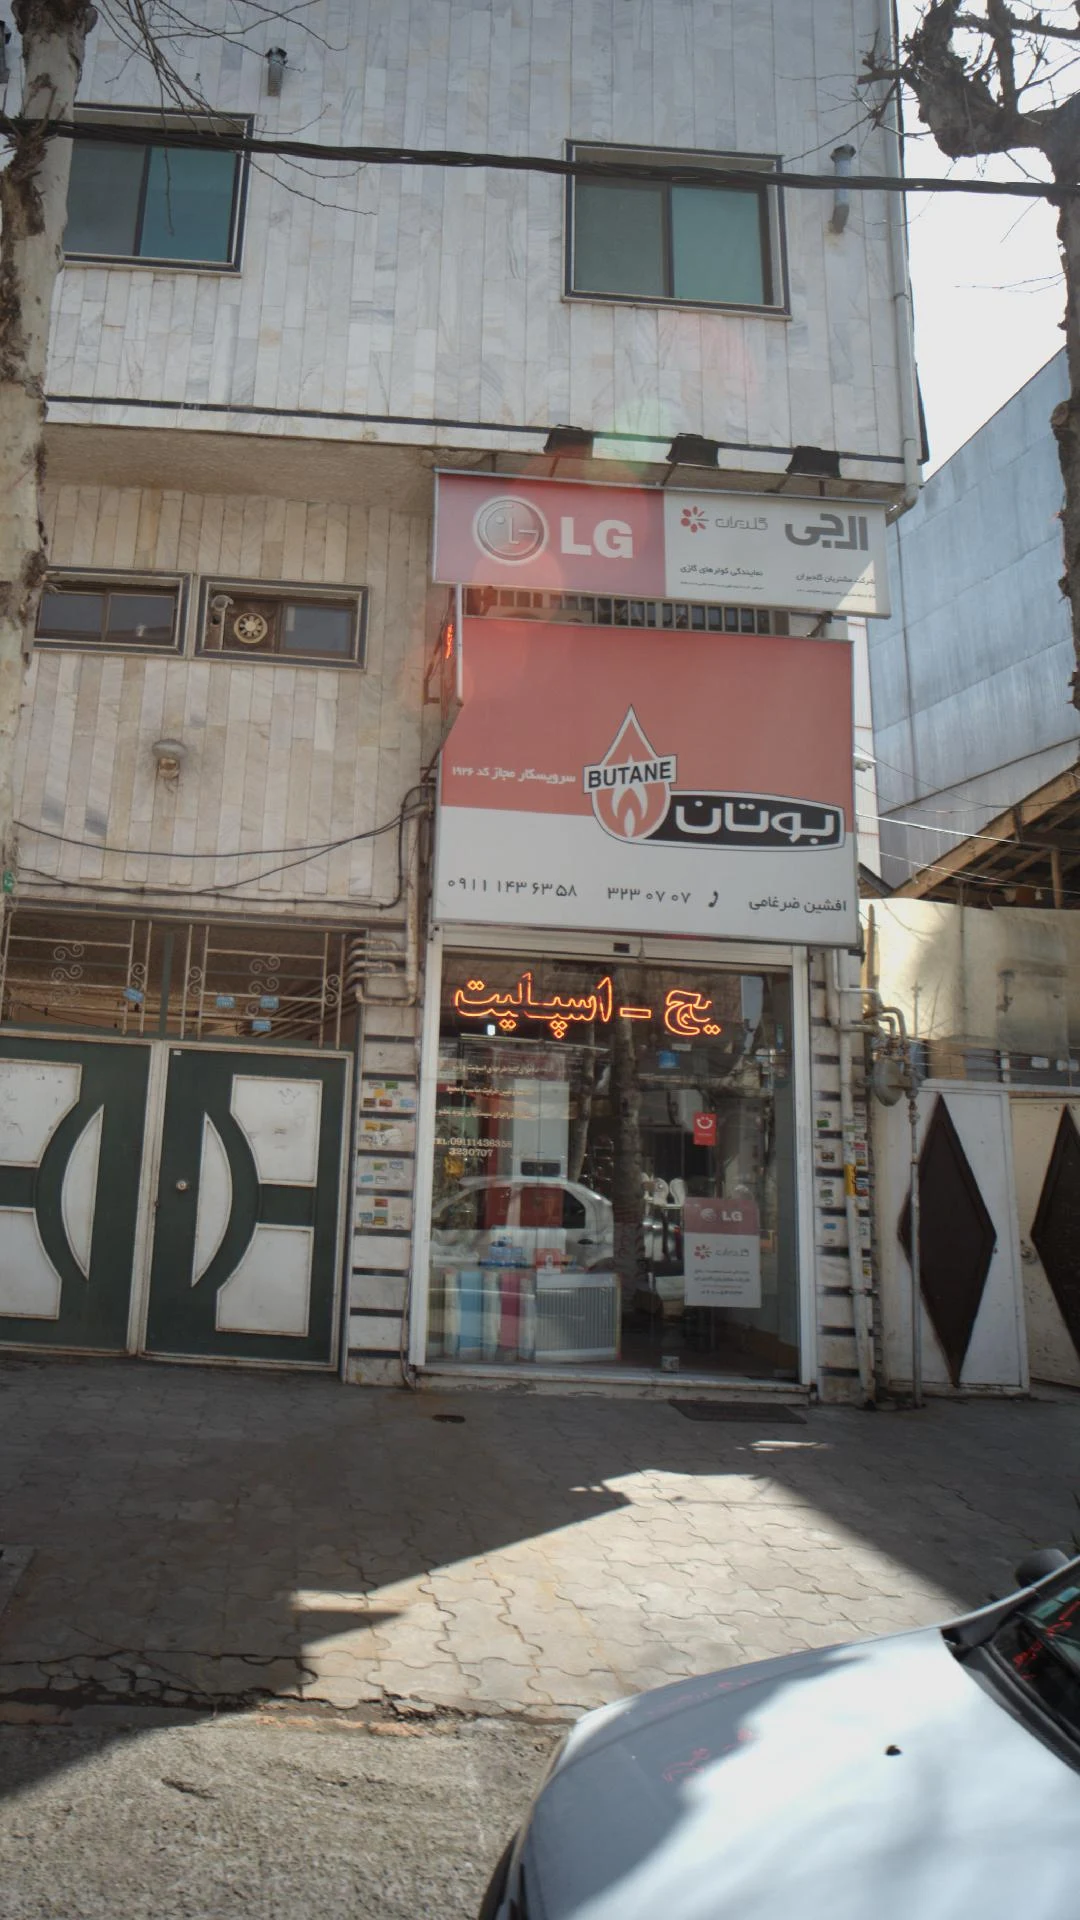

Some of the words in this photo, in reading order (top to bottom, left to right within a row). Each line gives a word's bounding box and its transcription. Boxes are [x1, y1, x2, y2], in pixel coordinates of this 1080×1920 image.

[559, 516, 634, 559] LG
[476, 767, 489, 776] کد
[492, 767, 515, 781] مجاز
[518, 768, 576, 784] سرویسکار
[588, 761, 672, 789] BUTANE
[675, 800, 834, 845] بوتان
[749, 895, 800, 913] ضرغامی
[804, 899, 847, 914] افشین
[455, 971, 613, 1039] اسپلیت
[721, 1210, 743, 1222] LG
